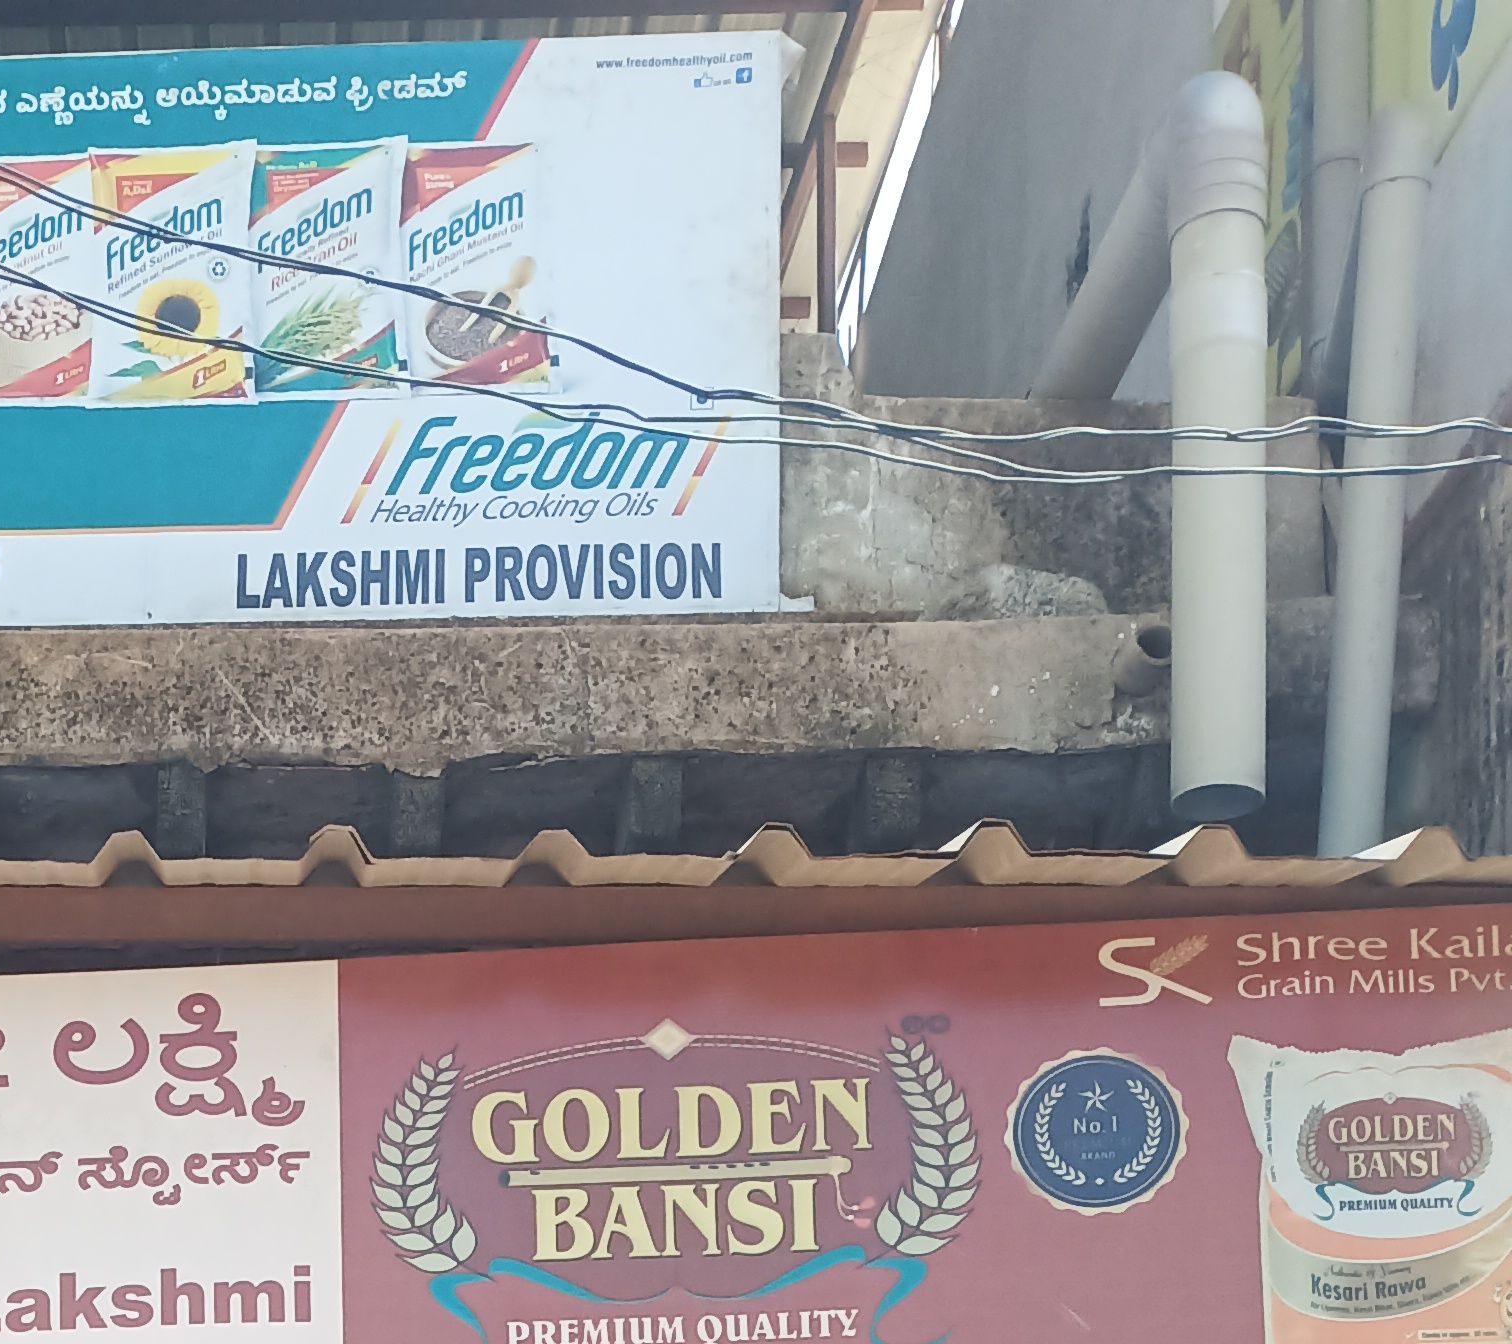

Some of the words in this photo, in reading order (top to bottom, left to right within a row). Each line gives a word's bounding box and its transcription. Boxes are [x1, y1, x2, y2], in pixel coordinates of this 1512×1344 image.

[408, 190, 524, 273] Freedom
[386, 411, 689, 496] Freedom
[371, 497, 479, 528] Healthy
[483, 492, 598, 524] Cooking
[605, 492, 660, 518] Oils
[236, 547, 446, 609] LAKSHMI
[464, 542, 723, 603] PROVISION
[1235, 930, 1389, 967] Shree
[1236, 969, 1336, 999] Grain
[1348, 966, 1436, 995] Mills
[470, 1077, 873, 1165] GOLDEN
[1327, 1112, 1457, 1145] GOLDEN
[1347, 1149, 1439, 1180] BANSI
[531, 1178, 820, 1263] BANSI
[1338, 1198, 1398, 1212] PREMIUM
[1400, 1196, 1454, 1212] QUALITY
[1310, 1272, 1369, 1302] Kesari
[1374, 1275, 1427, 1300] Rawa
